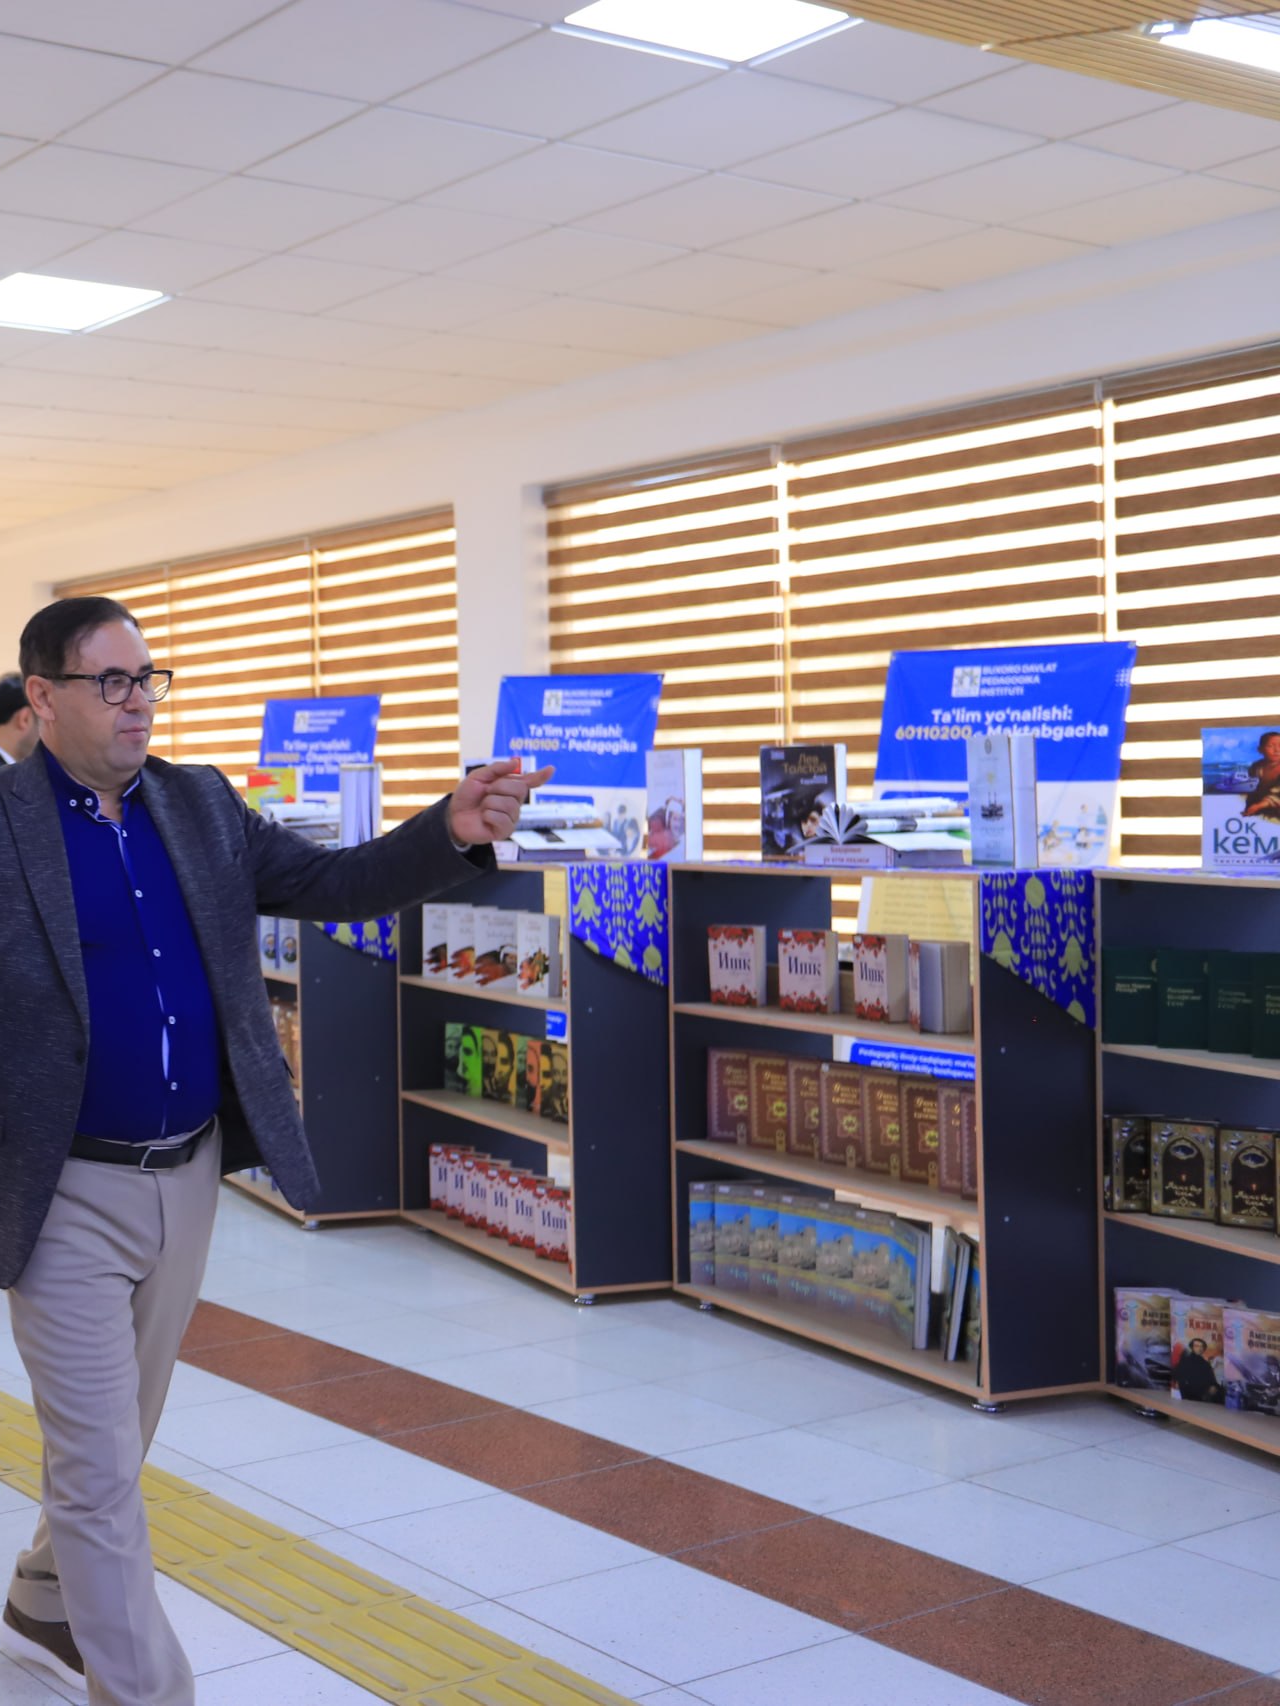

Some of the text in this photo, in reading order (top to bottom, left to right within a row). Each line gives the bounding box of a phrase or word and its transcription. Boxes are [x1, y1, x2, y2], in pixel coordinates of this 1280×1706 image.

[1021, 663, 1058, 674] DAVLAT
[980, 686, 1024, 696] INSTITUTI
[932, 708, 981, 724] Ta'lim
[895, 725, 972, 740] 60110200
[987, 722, 1109, 741] Maktabgacha
[568, 738, 637, 755] Pedagogika
